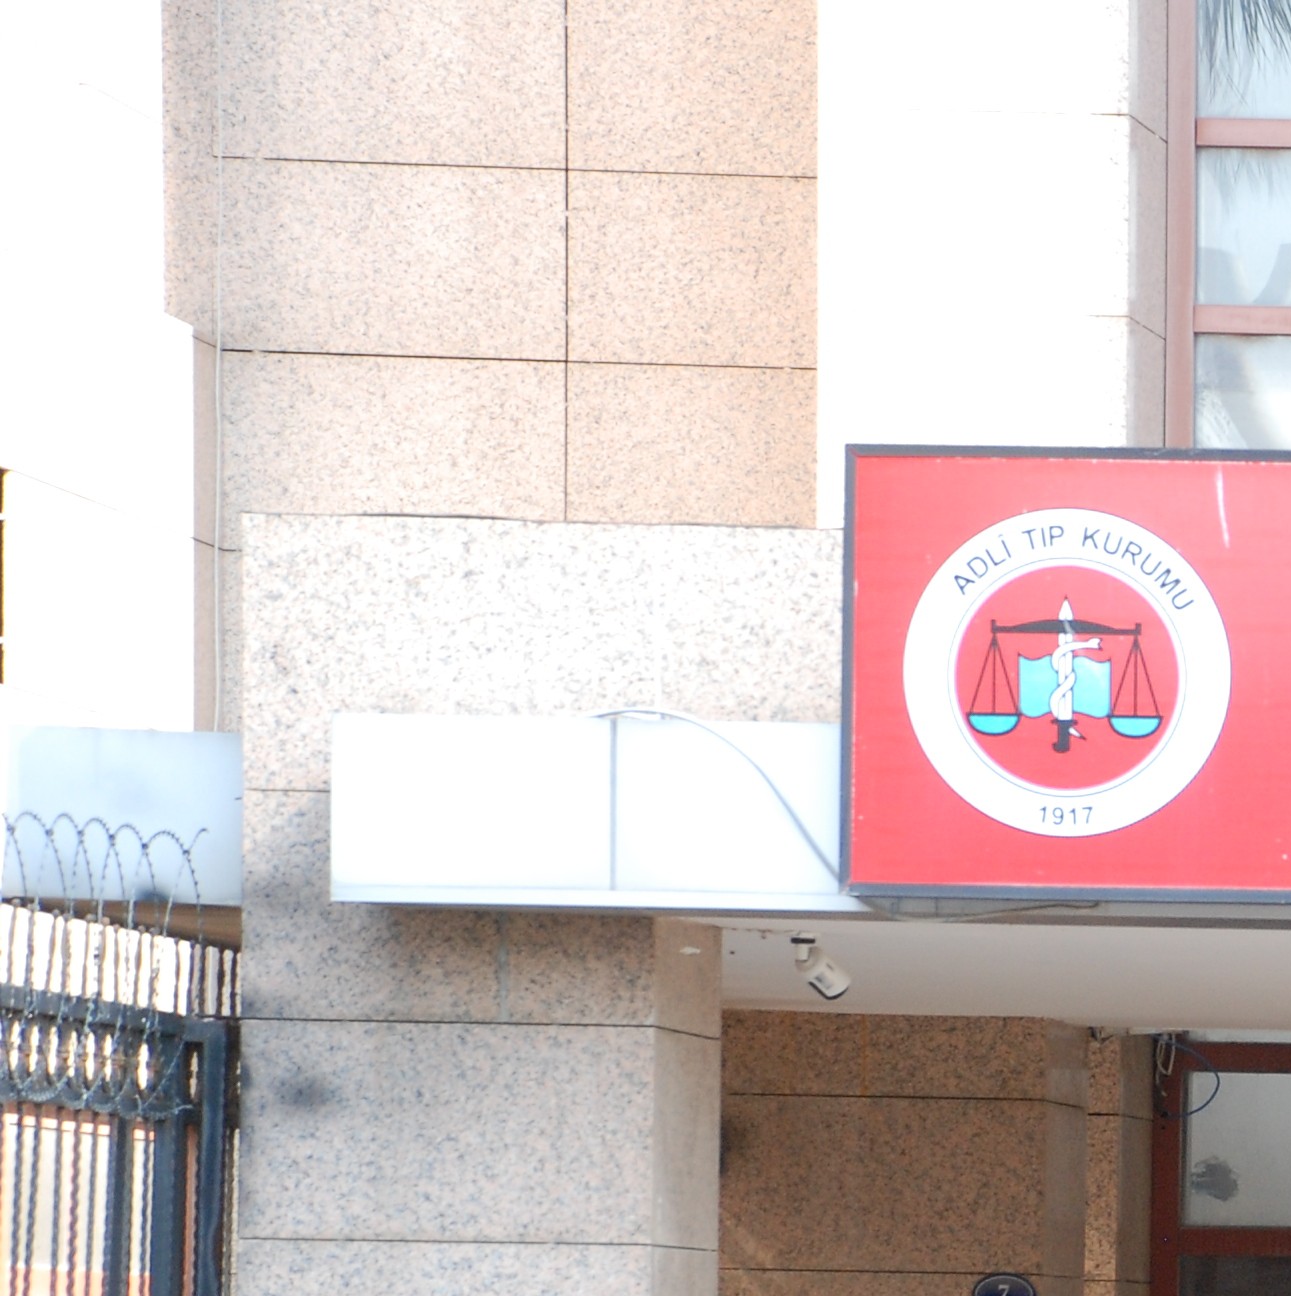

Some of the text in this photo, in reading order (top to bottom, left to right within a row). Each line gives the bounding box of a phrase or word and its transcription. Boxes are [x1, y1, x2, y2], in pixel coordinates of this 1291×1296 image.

[952, 524, 1196, 612] ADLİ TIP KURUMU
[1038, 805, 1094, 827] 1917
